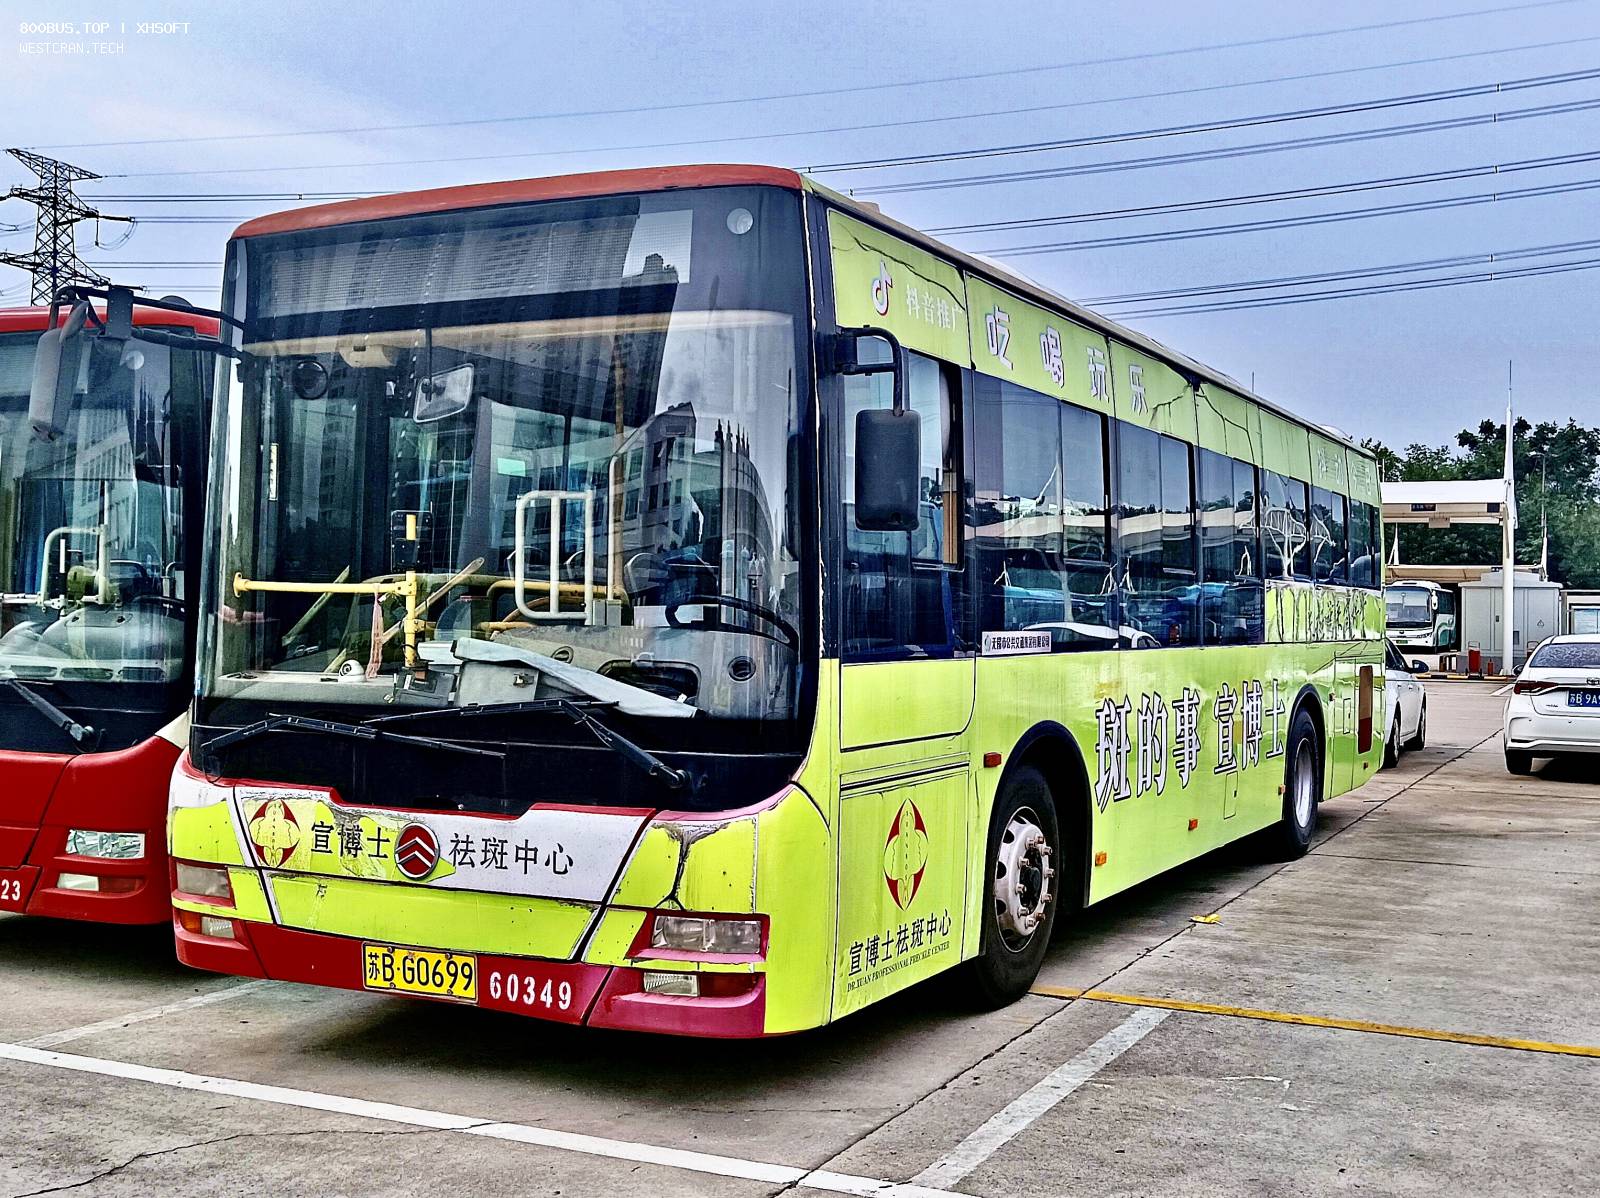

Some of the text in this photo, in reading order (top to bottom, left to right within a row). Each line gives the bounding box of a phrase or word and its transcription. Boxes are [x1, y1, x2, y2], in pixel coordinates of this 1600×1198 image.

[906, 284, 962, 332] 抖音推广
[974, 303, 1149, 416] 吃喝玩乐
[1095, 679, 1286, 813] 斑的事 宣博士
[310, 820, 391, 860] 宣博士
[449, 832, 574, 876] 祛斑中心
[848, 908, 952, 977] 宣博士祛斑中心
[489, 971, 572, 1010] 60349
